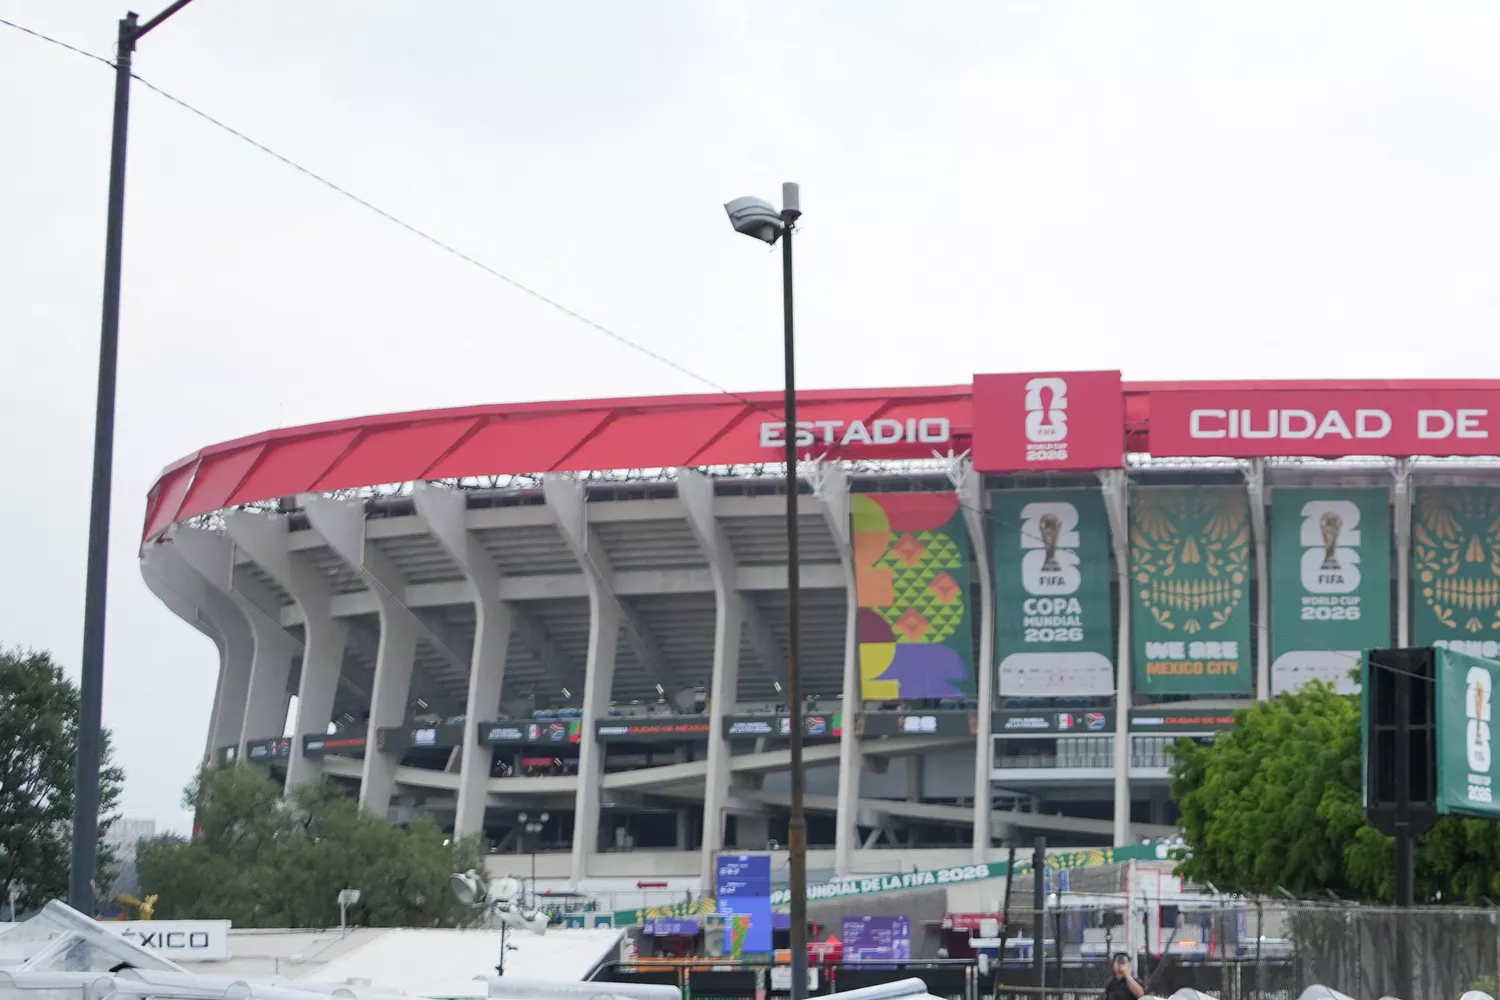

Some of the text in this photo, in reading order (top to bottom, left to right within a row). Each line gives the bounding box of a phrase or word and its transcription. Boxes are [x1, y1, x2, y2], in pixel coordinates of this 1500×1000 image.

[760, 418, 950, 447] ESTADIO
[1189, 409, 1393, 439] CIUDAD
[1417, 409, 1489, 438] DE
[1025, 450, 1068, 461] 2026
[1039, 575, 1066, 586] FIFA
[1318, 574, 1345, 584] FIFA
[1023, 597, 1082, 615] COPA
[1301, 596, 1361, 605] WORLD CUP
[1301, 606, 1361, 620] 2026
[1023, 615, 1083, 627] MUNDIAL
[1023, 627, 1084, 642] 2026
[1146, 661, 1239, 676] MEXICO CITY
[806, 882, 860, 900] UNDIAL
[860, 880, 880, 892] DE
[881, 876, 902, 890] LA
[902, 872, 937, 887] FIFA
[937, 864, 990, 883] 2026
